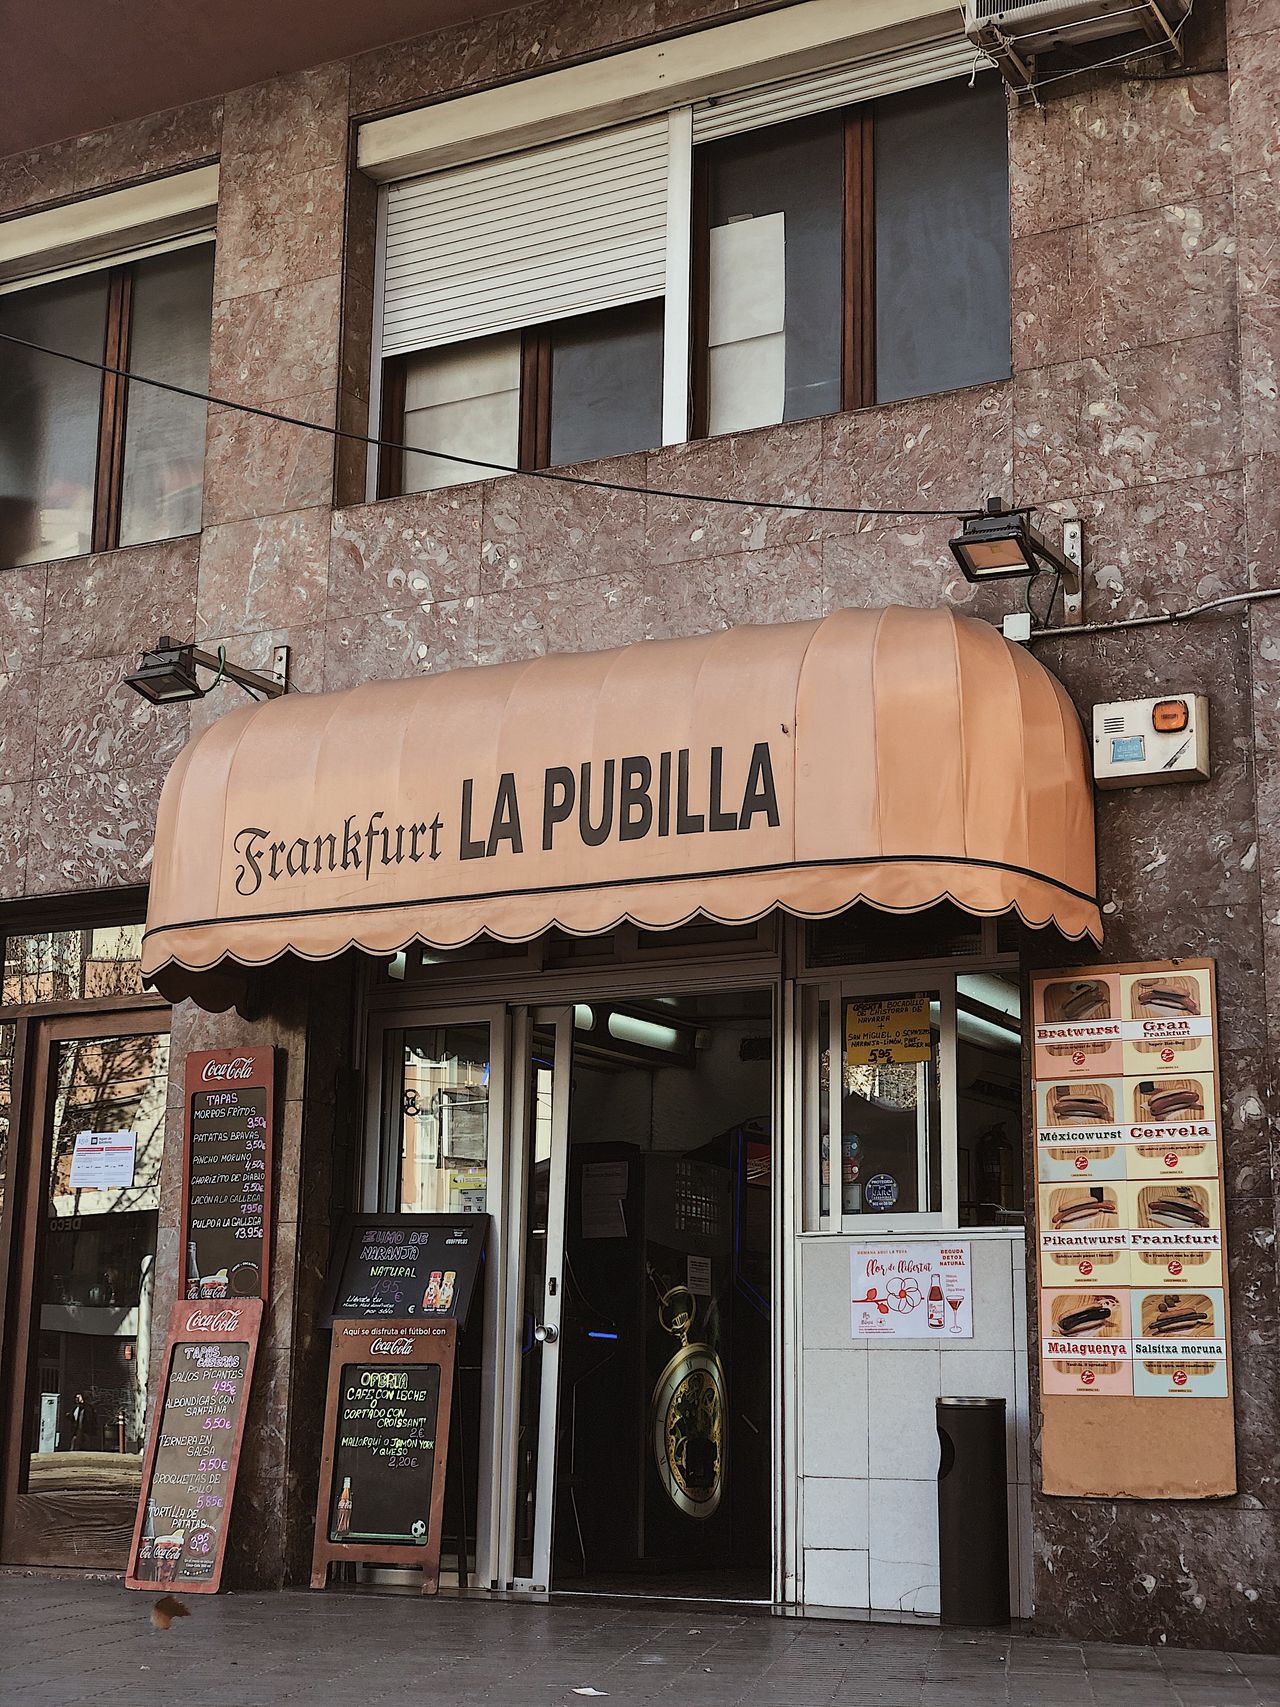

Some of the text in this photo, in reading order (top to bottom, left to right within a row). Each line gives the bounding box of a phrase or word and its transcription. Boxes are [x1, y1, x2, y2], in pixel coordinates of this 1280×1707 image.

[234, 741, 780, 896] Frankfurt LA PUBILLA
[887, 999, 924, 1009] BOCADILLO
[1142, 1019, 1190, 1032] Gran
[863, 1031, 891, 1039] MIGUEL
[1037, 1024, 1120, 1040] Bratwurst
[1143, 1030, 1191, 1038] Frankfurt
[202, 1057, 256, 1082] Coca-Cola
[206, 1092, 238, 1106] TAPAS
[194, 1105, 256, 1119] MORROS FRITOS
[193, 1131, 260, 1143] PATATAS BRAVAS
[1040, 1130, 1122, 1141] Méxicowurst
[1130, 1125, 1211, 1139] Cervela
[192, 1152, 252, 1164] PINCHO MORUNO
[191, 1173, 229, 1185] CHORIZITO
[230, 1173, 241, 1182] DE
[219, 1195, 228, 1204] LA
[229, 1193, 261, 1203] GALLEGA
[192, 1218, 216, 1228] PULPO
[222, 1218, 230, 1227] LA
[231, 1216, 261, 1226] GALLEGA
[362, 1230, 429, 1245] ZUMO DE
[1043, 1234, 1126, 1247] Pikantwurst
[1131, 1234, 1219, 1245] Frankfurt
[360, 1245, 419, 1261] NARANJA
[370, 1266, 416, 1278] NATURAL
[407, 1305, 416, 1314] €
[186, 1309, 243, 1332] Coca-Cola
[343, 1327, 361, 1336] Aquí
[371, 1327, 398, 1336] disfruta
[400, 1327, 407, 1336] el
[409, 1327, 430, 1336] fútbol
[370, 1337, 416, 1355] Coca-Cola
[1048, 1342, 1127, 1356] Malaguenya
[1135, 1343, 1222, 1355] Salsitxa moruna
[184, 1346, 221, 1360] TAPAS
[169, 1368, 244, 1383] CALLOS PICANTES
[361, 1372, 408, 1389] OFERTA
[218, 1395, 235, 1405] CON
[375, 1389, 394, 1400] CON
[396, 1390, 427, 1401] LECHE
[344, 1408, 406, 1420] CORTADO CON
[377, 1417, 427, 1429] CROISSANT
[159, 1434, 212, 1447] TERNERA EN
[419, 1439, 434, 1450] YORK
[186, 1445, 215, 1457] SALSA
[372, 1447, 408, 1456] Y QUESO
[153, 1473, 222, 1484] CROQUETAS DE
[187, 1485, 213, 1494] POLLO
[148, 1504, 199, 1519] TORTILLA DE
[170, 1518, 206, 1529] PATATAS
